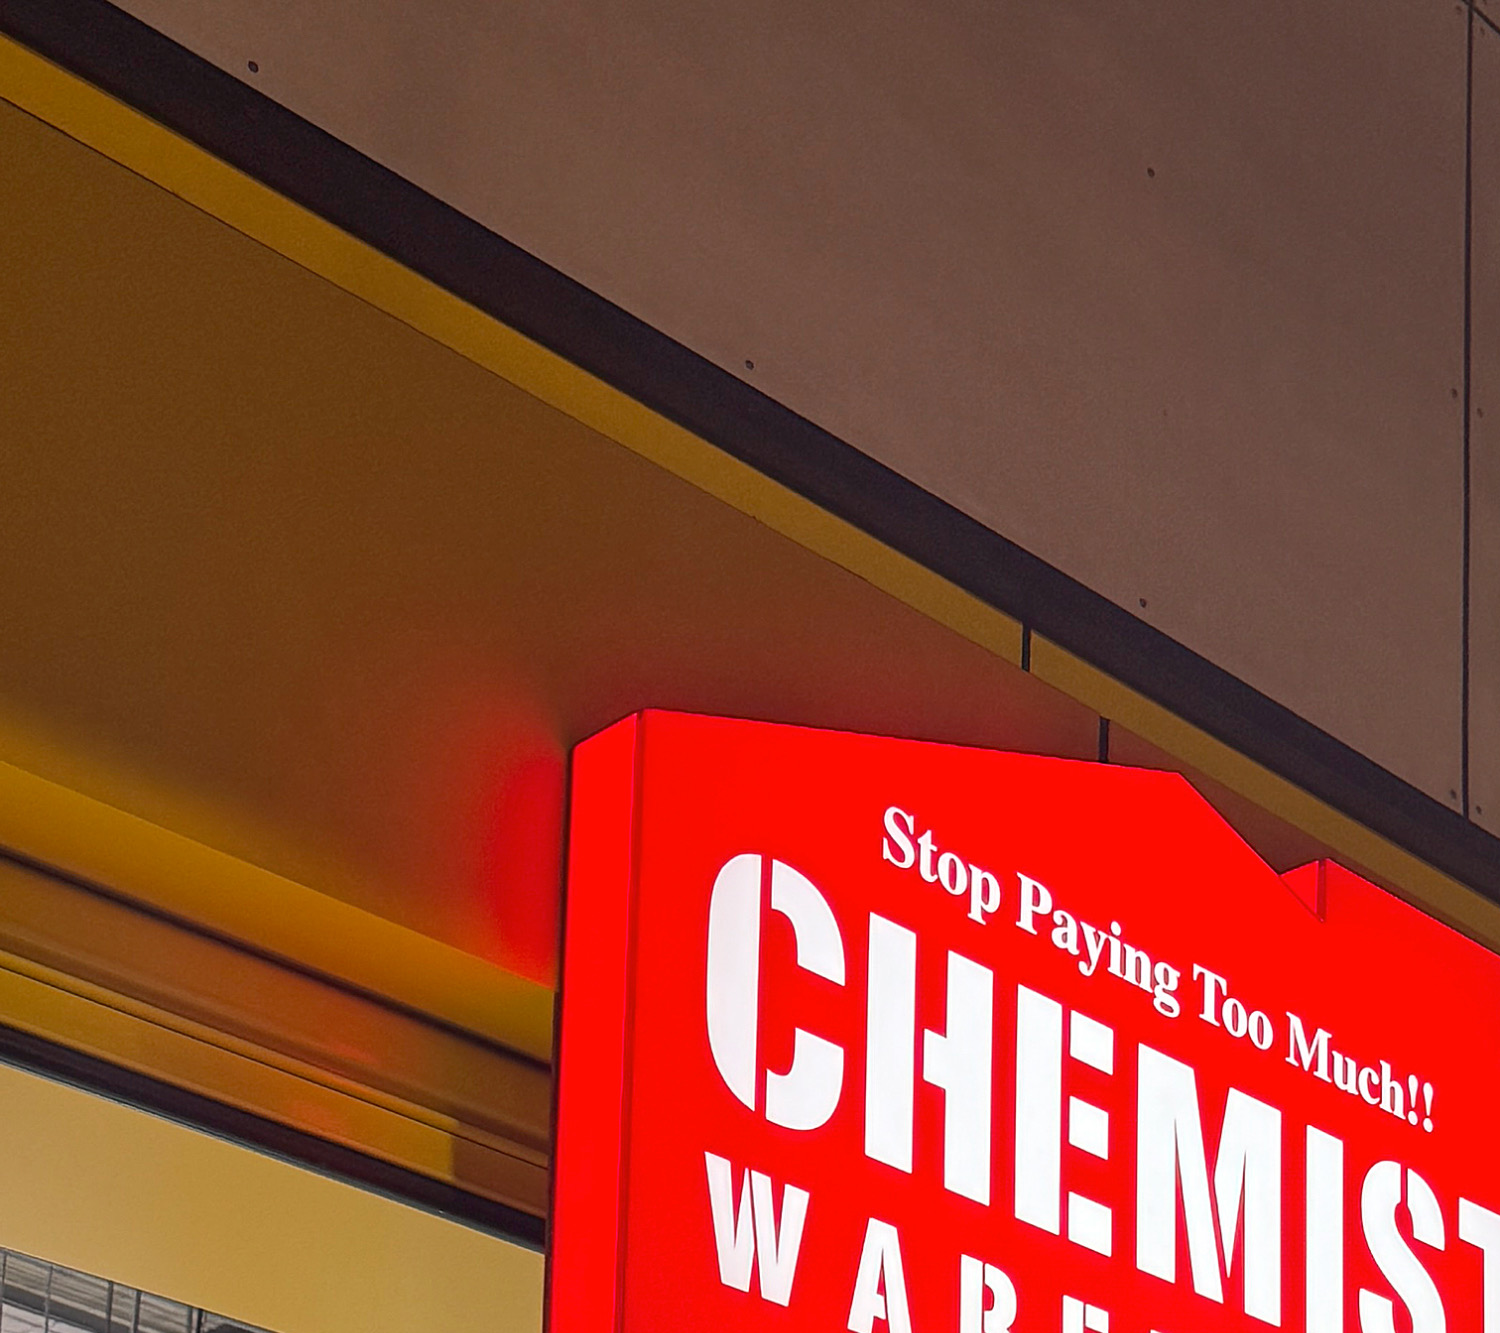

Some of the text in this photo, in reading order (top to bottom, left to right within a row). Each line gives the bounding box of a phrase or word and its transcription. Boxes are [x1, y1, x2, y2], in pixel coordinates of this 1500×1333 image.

[882, 806, 1436, 1134] Stop Paying Too Much!!
